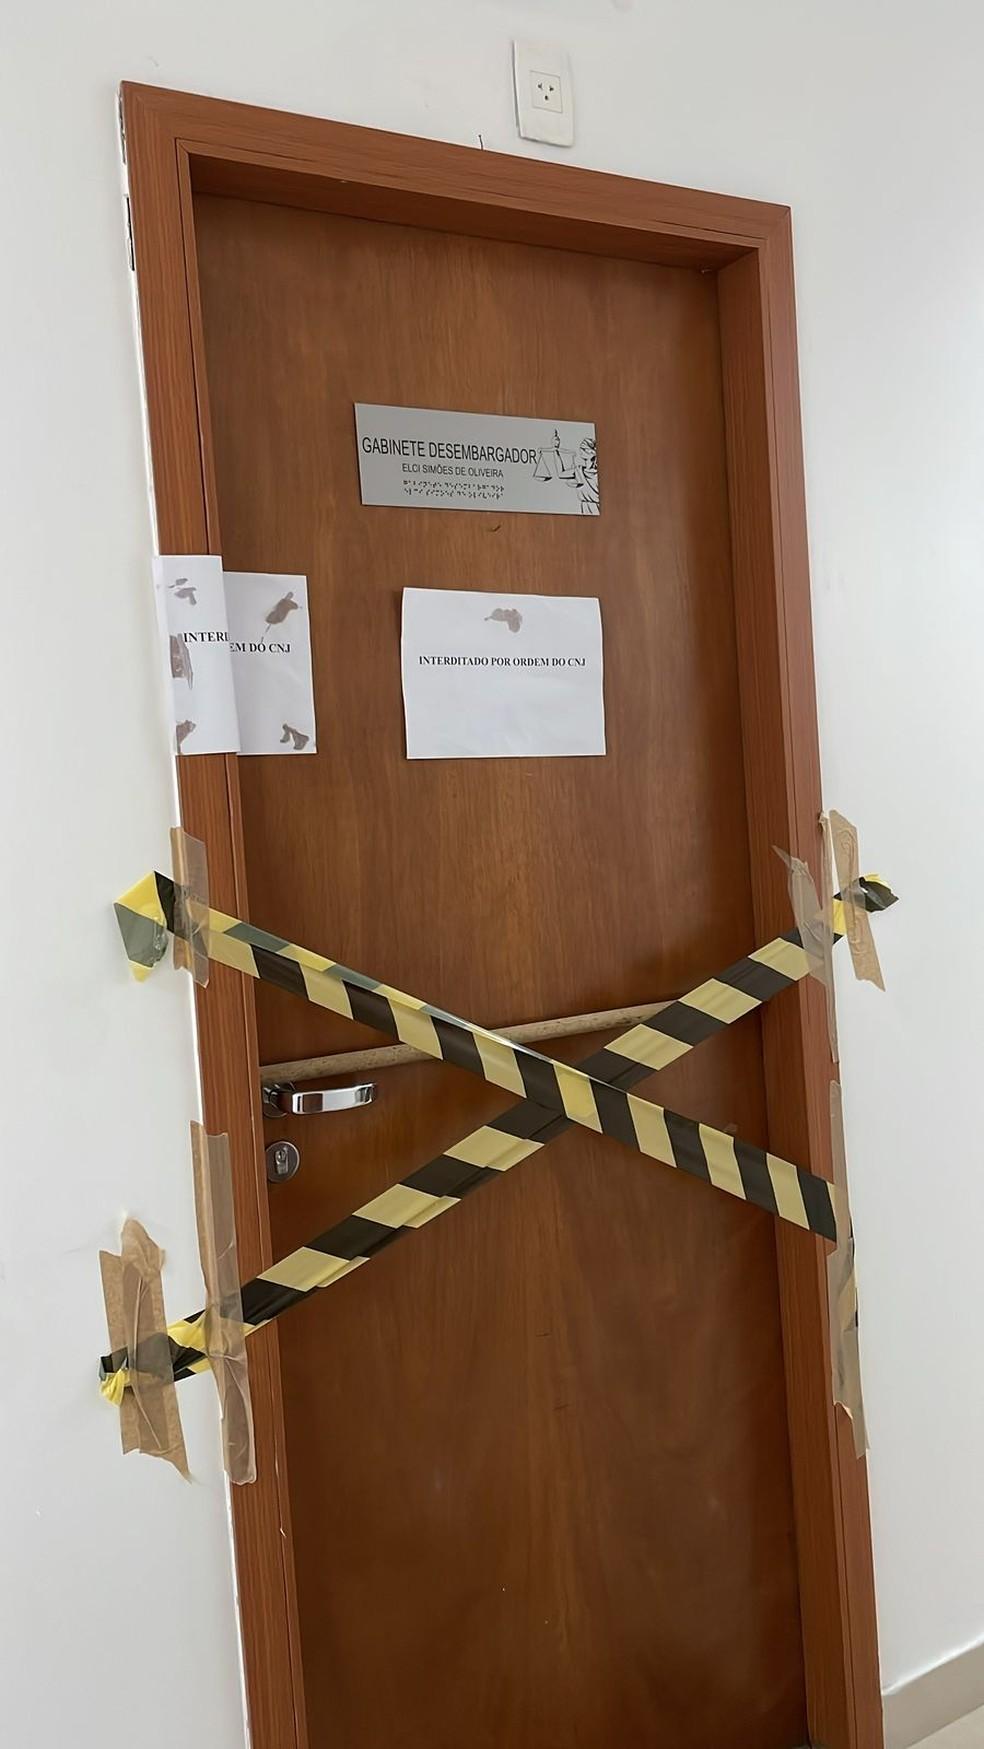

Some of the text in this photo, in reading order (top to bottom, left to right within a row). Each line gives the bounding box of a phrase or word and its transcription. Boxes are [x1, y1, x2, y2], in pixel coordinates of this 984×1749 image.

[362, 437, 537, 464] GABINETE DESEMBARGADOR
[402, 463, 504, 478] ELCI SIMÕES DE OLIVEIRA
[250, 643, 266, 653] DO
[269, 643, 291, 653] CNJ
[419, 655, 586, 667] INTERDITADO POR ORDEM DO CNJ
